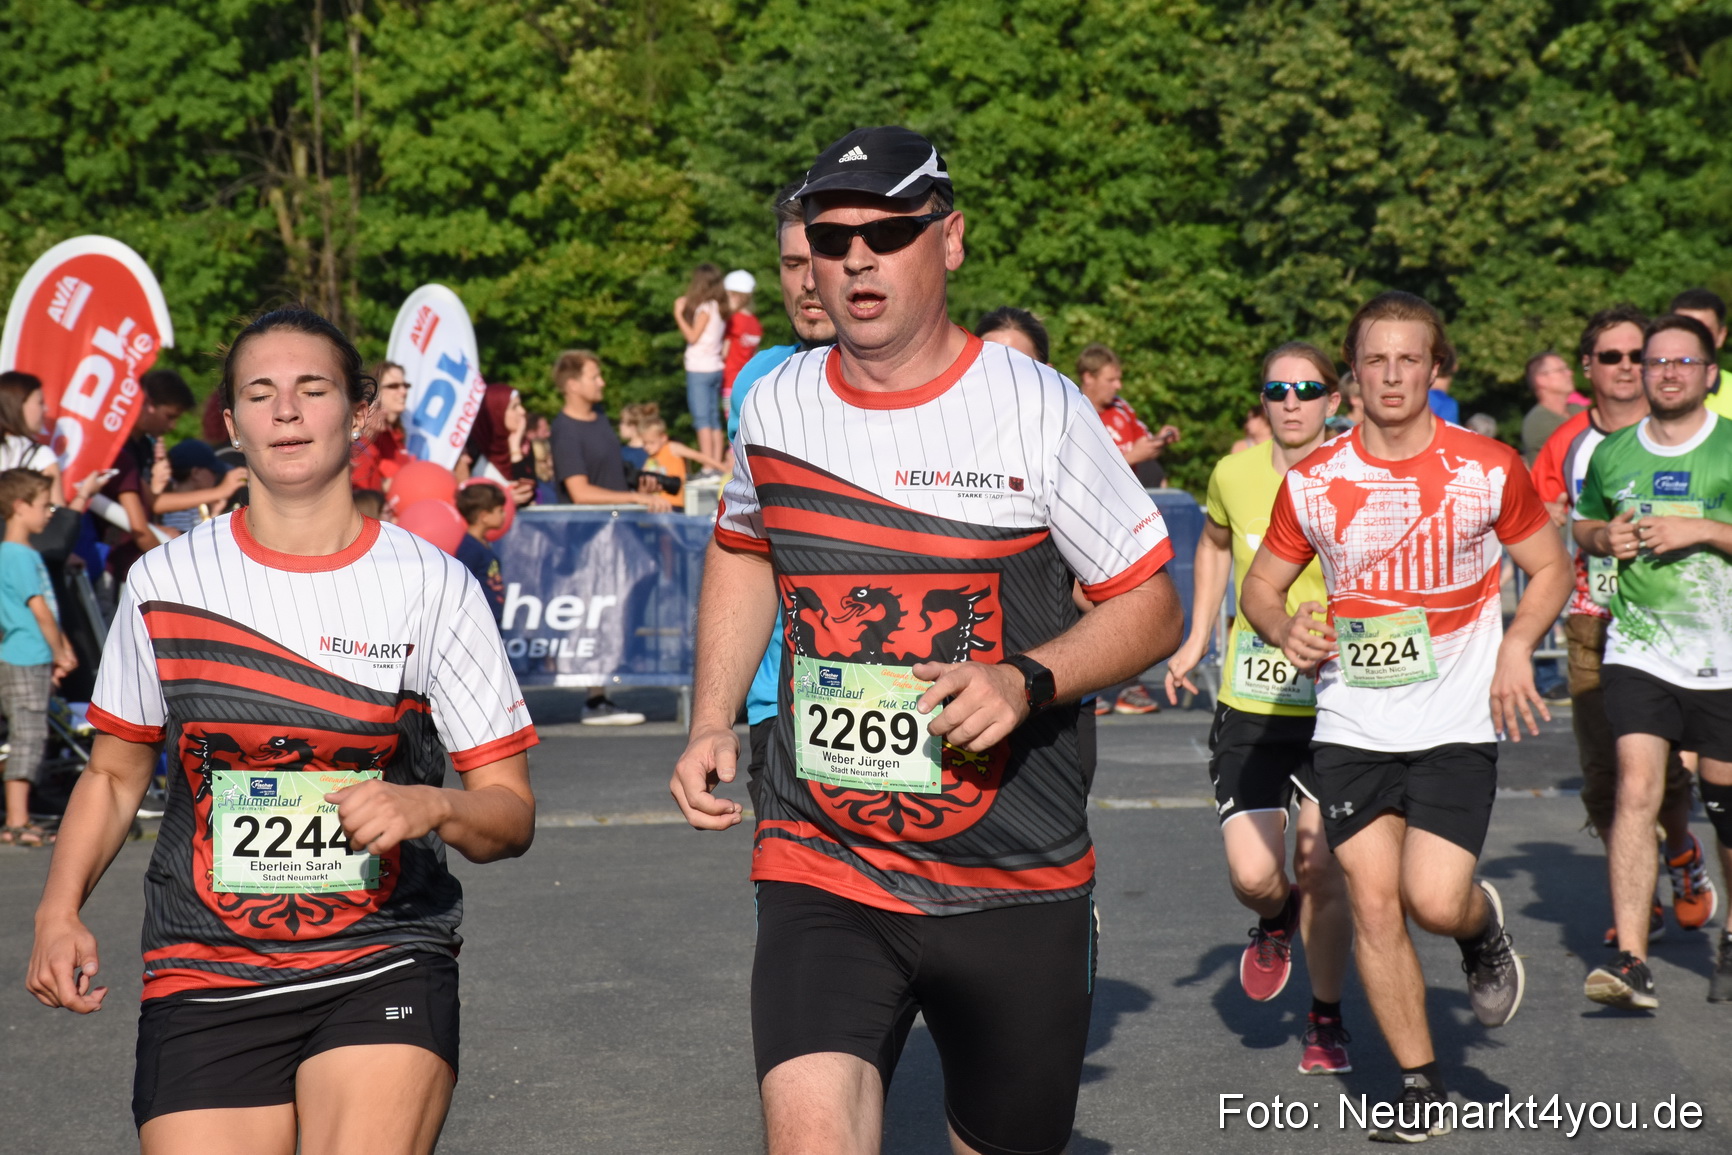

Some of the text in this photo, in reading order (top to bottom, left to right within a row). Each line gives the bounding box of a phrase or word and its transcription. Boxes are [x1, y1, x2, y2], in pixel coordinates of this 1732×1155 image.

[838, 153, 868, 163] adidas
[410, 304, 432, 347] AVIA
[895, 470, 1005, 489] NEUMARKT
[502, 582, 617, 631] her
[505, 637, 597, 659] OBILE
[1347, 636, 1420, 667] 2224
[1365, 667, 1388, 675] Rauch
[810, 681, 865, 700] firmenlauf
[808, 703, 919, 756] 2269
[822, 750, 901, 770] Weber Jürgen
[830, 765, 889, 778] Stadt Neumarkt
[238, 794, 303, 807] firmenlauf
[232, 814, 354, 858] 2244
[249, 859, 343, 872] Eberlein Sarah
[262, 873, 329, 882] Stadt Neumarkt
